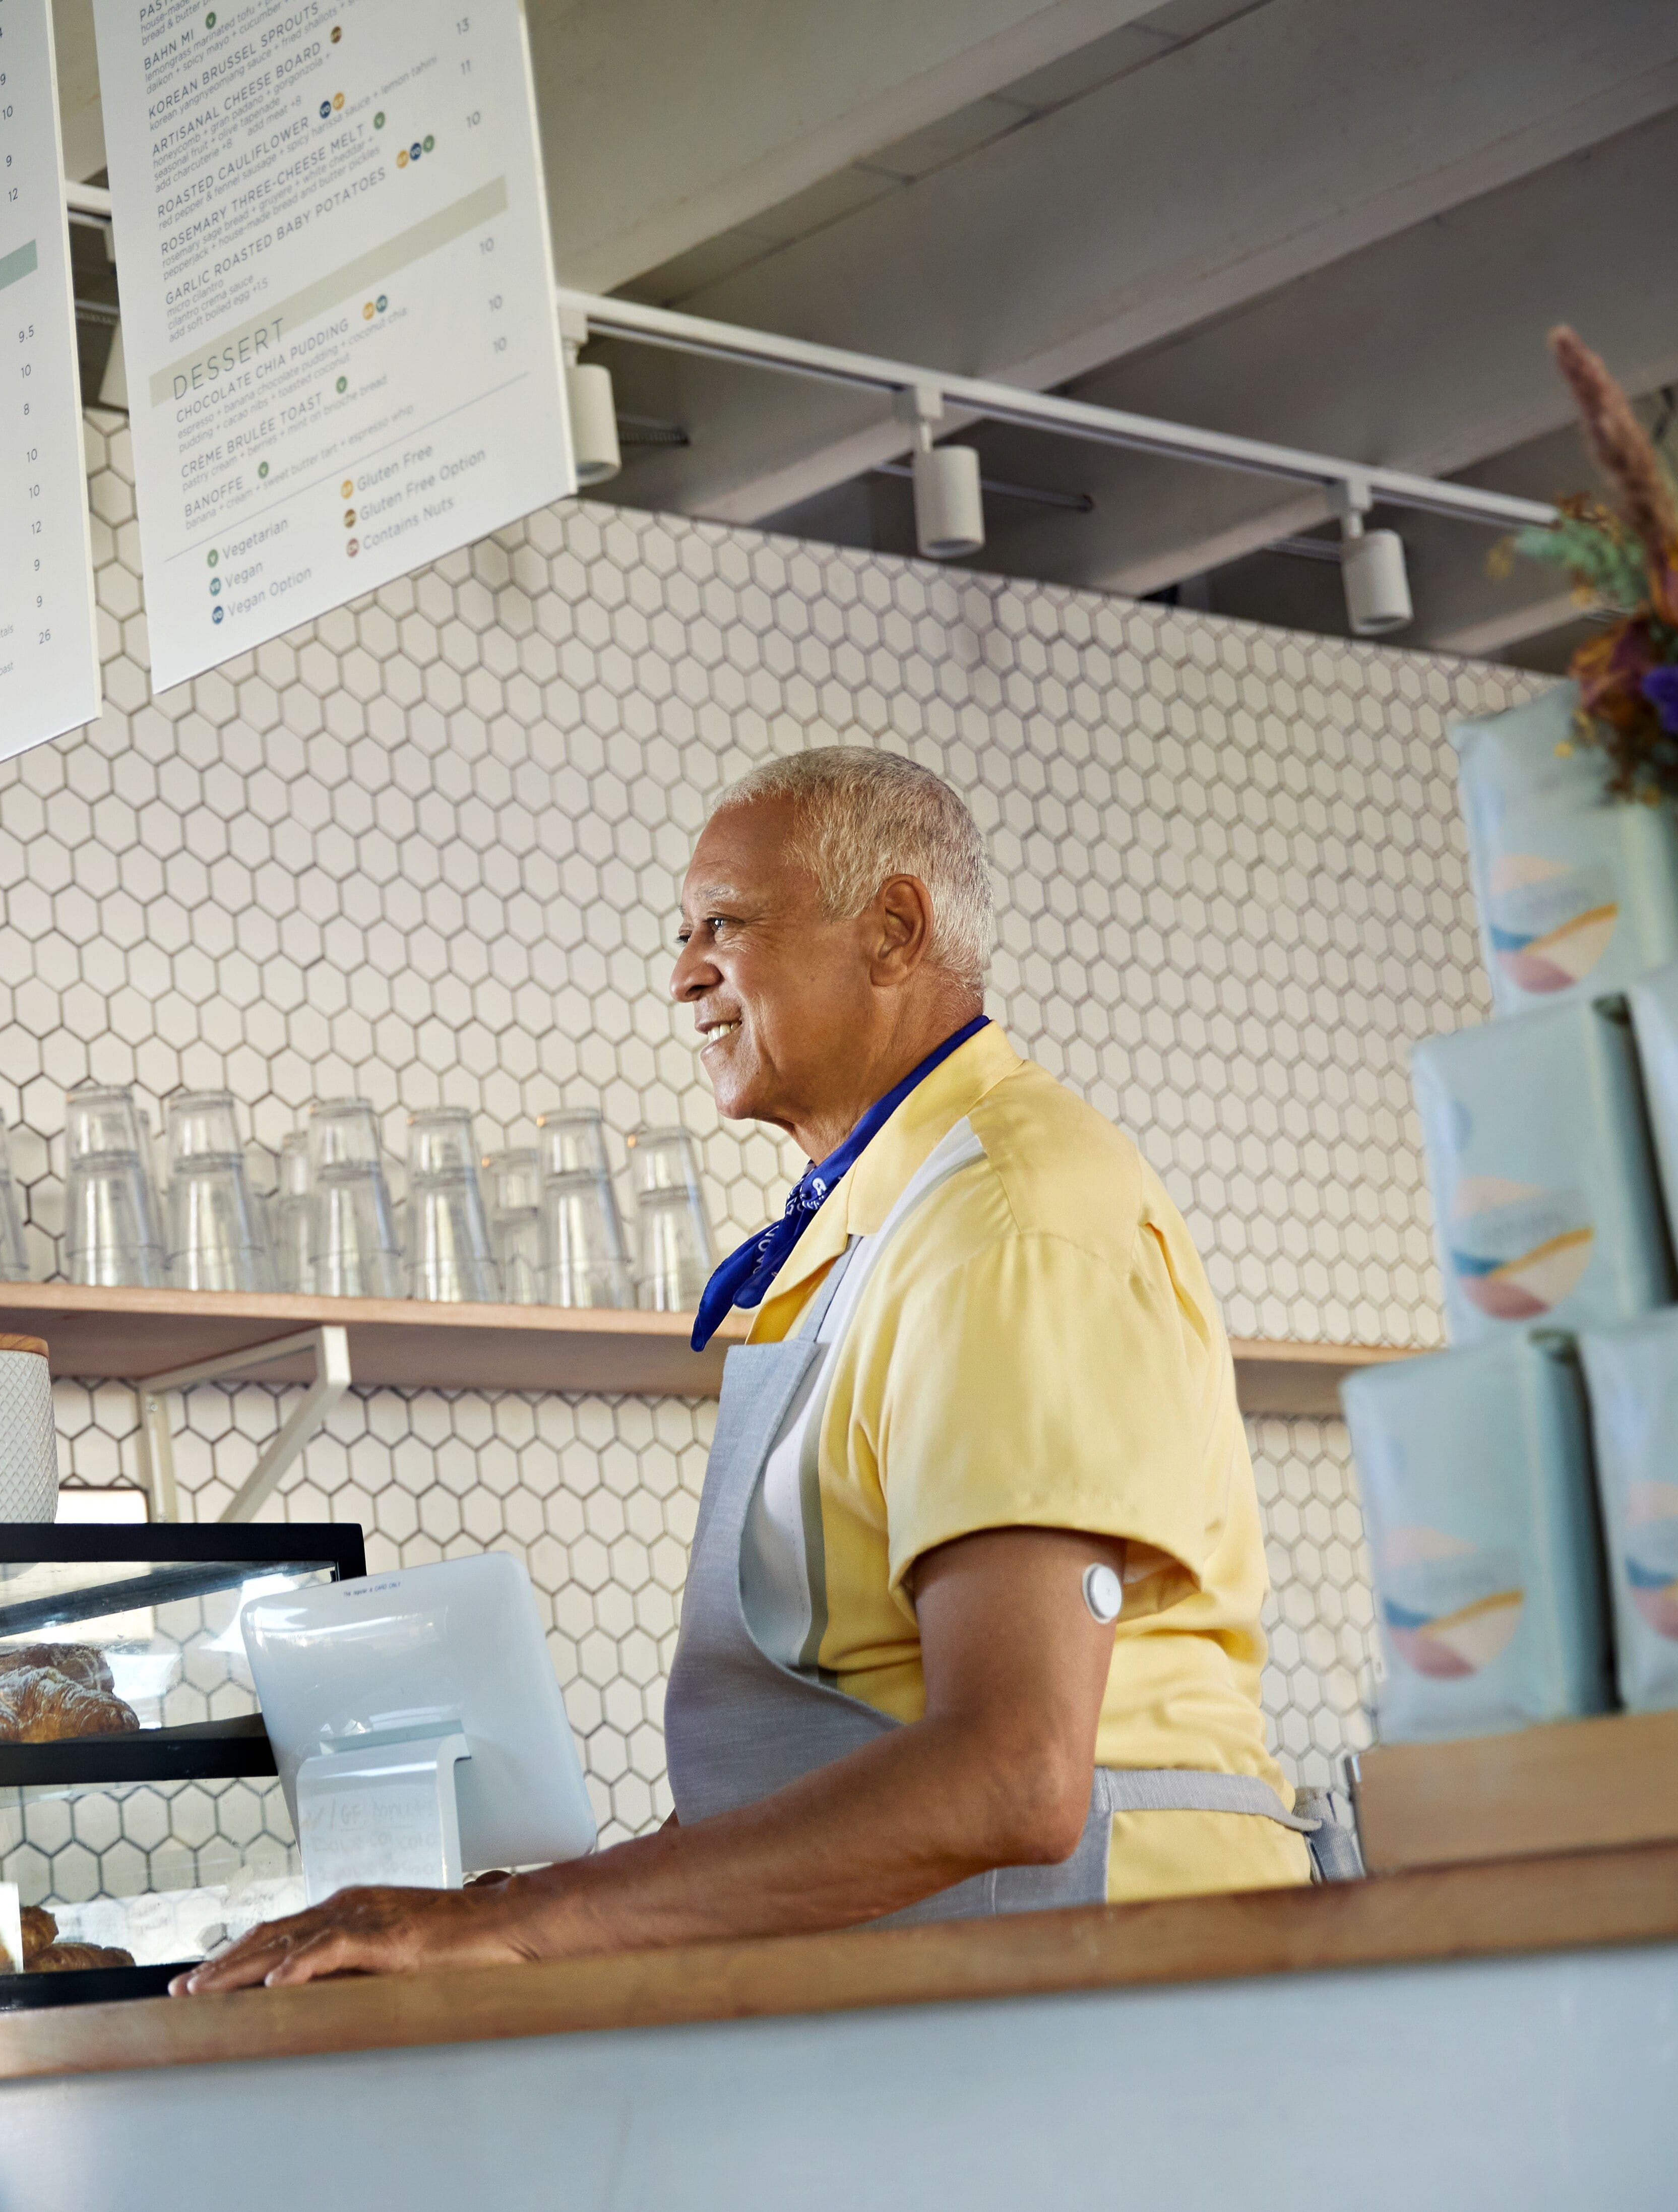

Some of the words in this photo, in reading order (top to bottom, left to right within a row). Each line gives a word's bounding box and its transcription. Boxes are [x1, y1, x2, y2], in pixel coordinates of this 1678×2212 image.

[140, 0, 172, 22] PAS
[456, 17, 470, 35] 13
[144, 40, 177, 71] BAHN
[181, 29, 194, 46] MI
[145, 47, 192, 83] lemongrass
[194, 17, 235, 50] marinated
[237, 6, 255, 23] tofu
[146, 72, 173, 95] daikon
[206, 36, 229, 55] mayo
[239, 1, 282, 34] cucumber
[149, 79, 198, 119] KOREAN
[202, 43, 256, 85] BRUSSEL
[261, 1, 319, 47] SPROUTS
[0, 74, 6, 85] 9
[149, 109, 177, 132] korean
[281, 29, 301, 45] fried
[460, 59, 471, 75] 11
[2, 105, 13, 120] 10
[152, 107, 220, 157] ARTISANAL
[224, 72, 271, 110] CHEESE
[276, 42, 321, 79] BOARD
[466, 110, 481, 128] 10
[153, 134, 201, 169] honeycomb
[211, 116, 229, 135] gran
[232, 95, 263, 120] padano
[247, 119, 264, 136] add
[266, 104, 288, 121] meat
[6, 155, 12, 167] 9
[154, 154, 189, 181] seasonal
[191, 141, 208, 155] fruit
[218, 124, 238, 141] olive
[158, 175, 214, 218] ROASTED
[218, 116, 308, 180] CAULIFLOWER
[8, 188, 18, 202] 12
[155, 176, 171, 193] add
[159, 215, 173, 230] red
[174, 198, 204, 222] pepper
[214, 176, 240, 196] fennel
[242, 153, 277, 179] sausage
[161, 207, 226, 256] ROSEMARY
[231, 146, 325, 211] THREE-CHEESE
[330, 124, 363, 152] MELT
[162, 242, 200, 268] rosemary
[203, 227, 222, 244] sage
[163, 247, 209, 282] pepperjack
[218, 211, 271, 245] house-made
[165, 270, 210, 305] GARLIC
[214, 234, 272, 276] ROASTED
[277, 210, 310, 240] BABY
[316, 167, 386, 217] POTATOES
[479, 236, 494, 255] 10
[166, 299, 190, 318] micro
[193, 279, 224, 303] cilantro
[168, 307, 199, 330] cilantro
[201, 290, 227, 311] crema
[169, 326, 185, 343] add
[187, 316, 203, 333] soft
[205, 299, 231, 322] boiled
[233, 290, 251, 305] egg
[488, 294, 503, 312] 10
[18, 325, 34, 343] 9.5
[492, 336, 508, 354] 10
[21, 363, 31, 379] 10
[173, 317, 283, 400] DESSERT
[176, 372, 251, 423] CHOCOLATE
[256, 354, 286, 379] CHIA
[290, 318, 349, 359] PUDDING
[24, 403, 30, 415] 8
[280, 392, 322, 423] TOAST
[26, 448, 38, 463] 10
[357, 462, 399, 491] Gluten
[403, 445, 433, 467] Free
[29, 484, 40, 499] 10
[184, 476, 243, 518] BANOFFE
[359, 491, 402, 520] Gluten
[406, 475, 436, 497] Free
[440, 449, 486, 481] Option
[31, 520, 41, 534] 12
[222, 519, 288, 560] Vegetarian
[362, 514, 419, 550] Contains
[423, 497, 454, 520] Nuts
[34, 559, 40, 572] 9
[225, 562, 263, 588] Vegan
[36, 595, 43, 608] 9
[227, 591, 266, 617] Vegan
[269, 568, 312, 597] Option
[39, 629, 51, 645] 26
